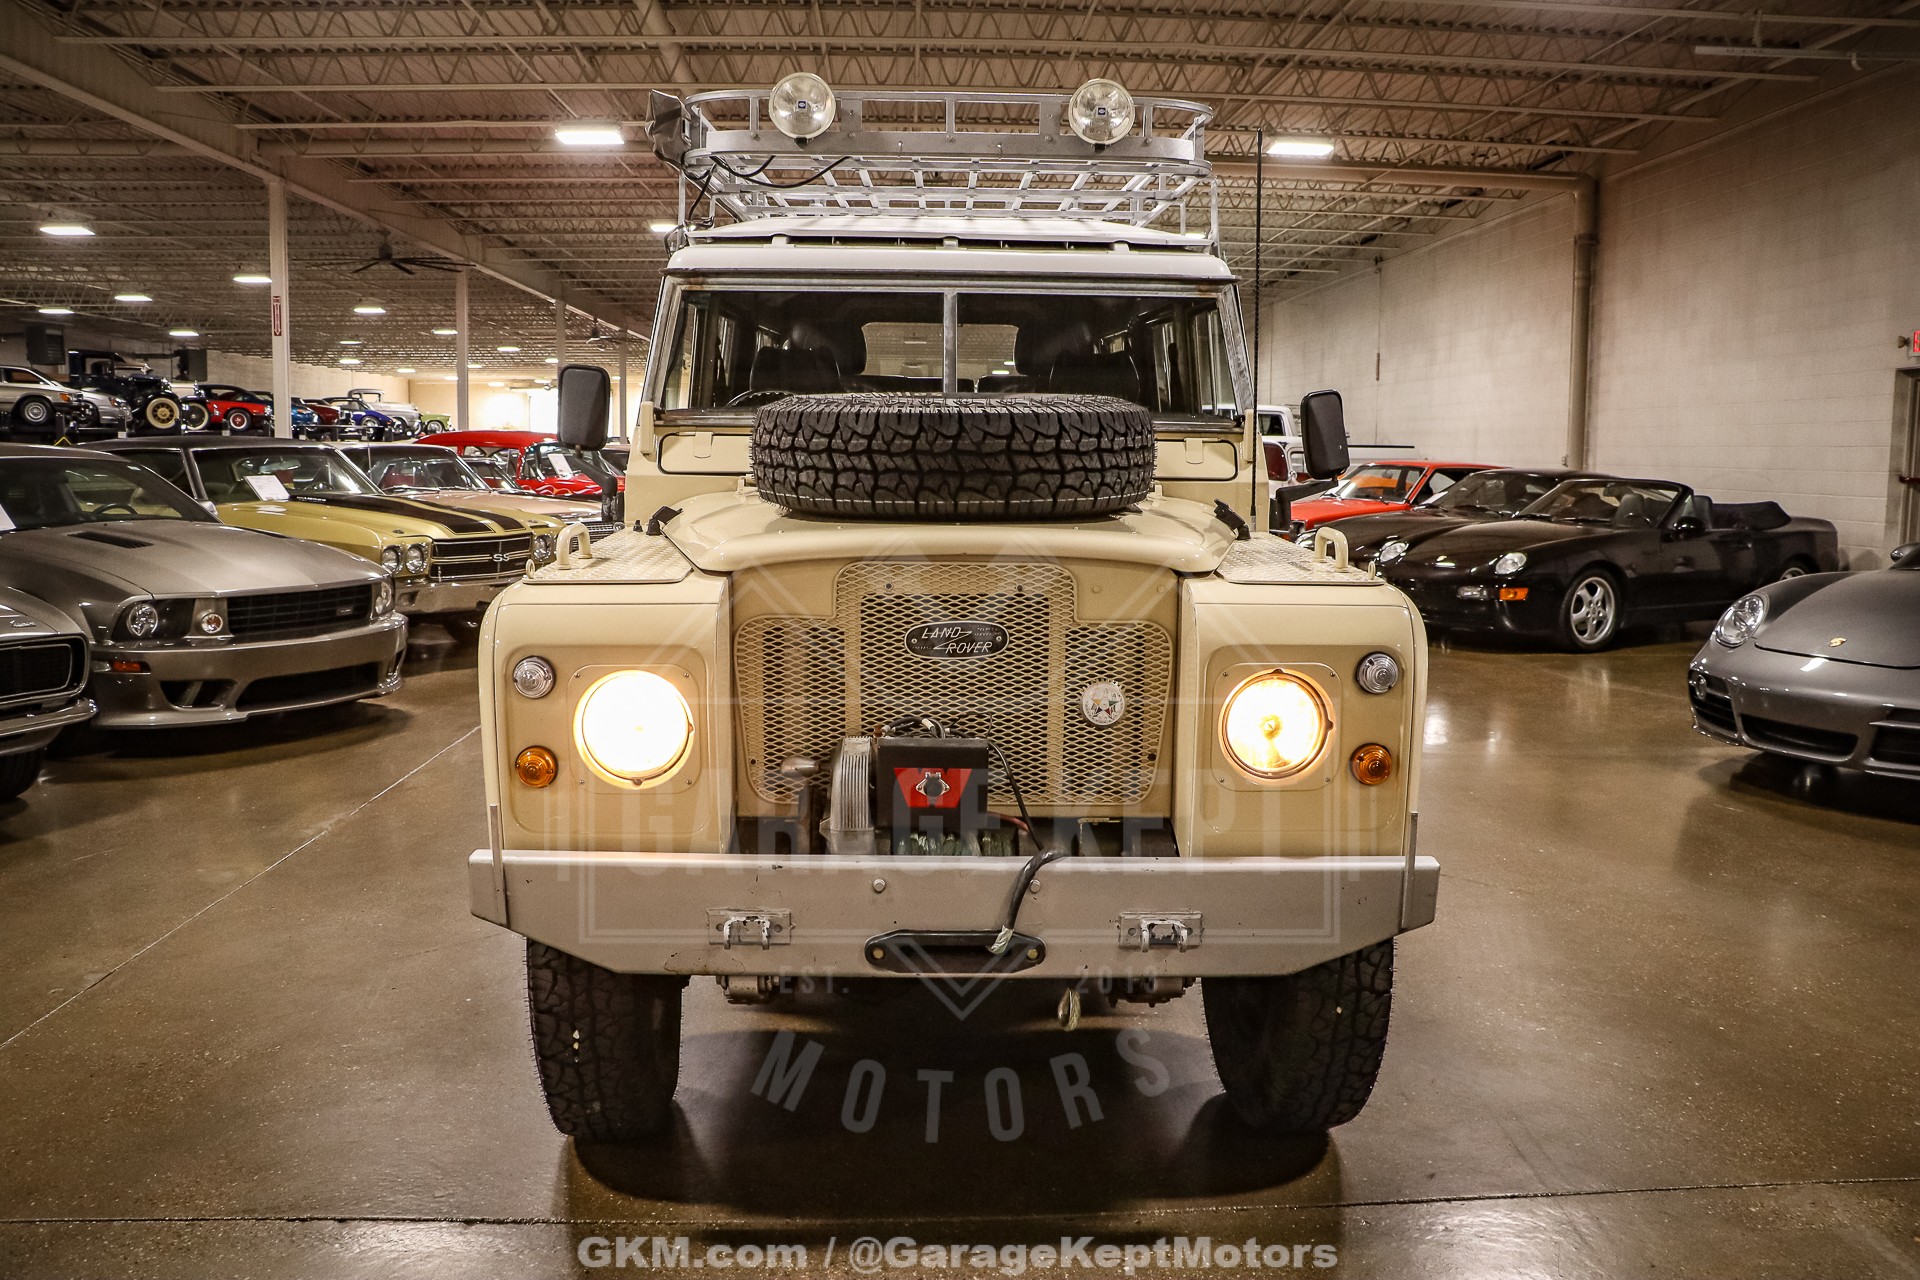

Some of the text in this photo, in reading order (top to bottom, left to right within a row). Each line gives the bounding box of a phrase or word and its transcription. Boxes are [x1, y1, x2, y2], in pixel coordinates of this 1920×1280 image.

[493, 553, 510, 562] SS
[921, 626, 962, 639] LAND
[945, 641, 993, 654] ROVER
